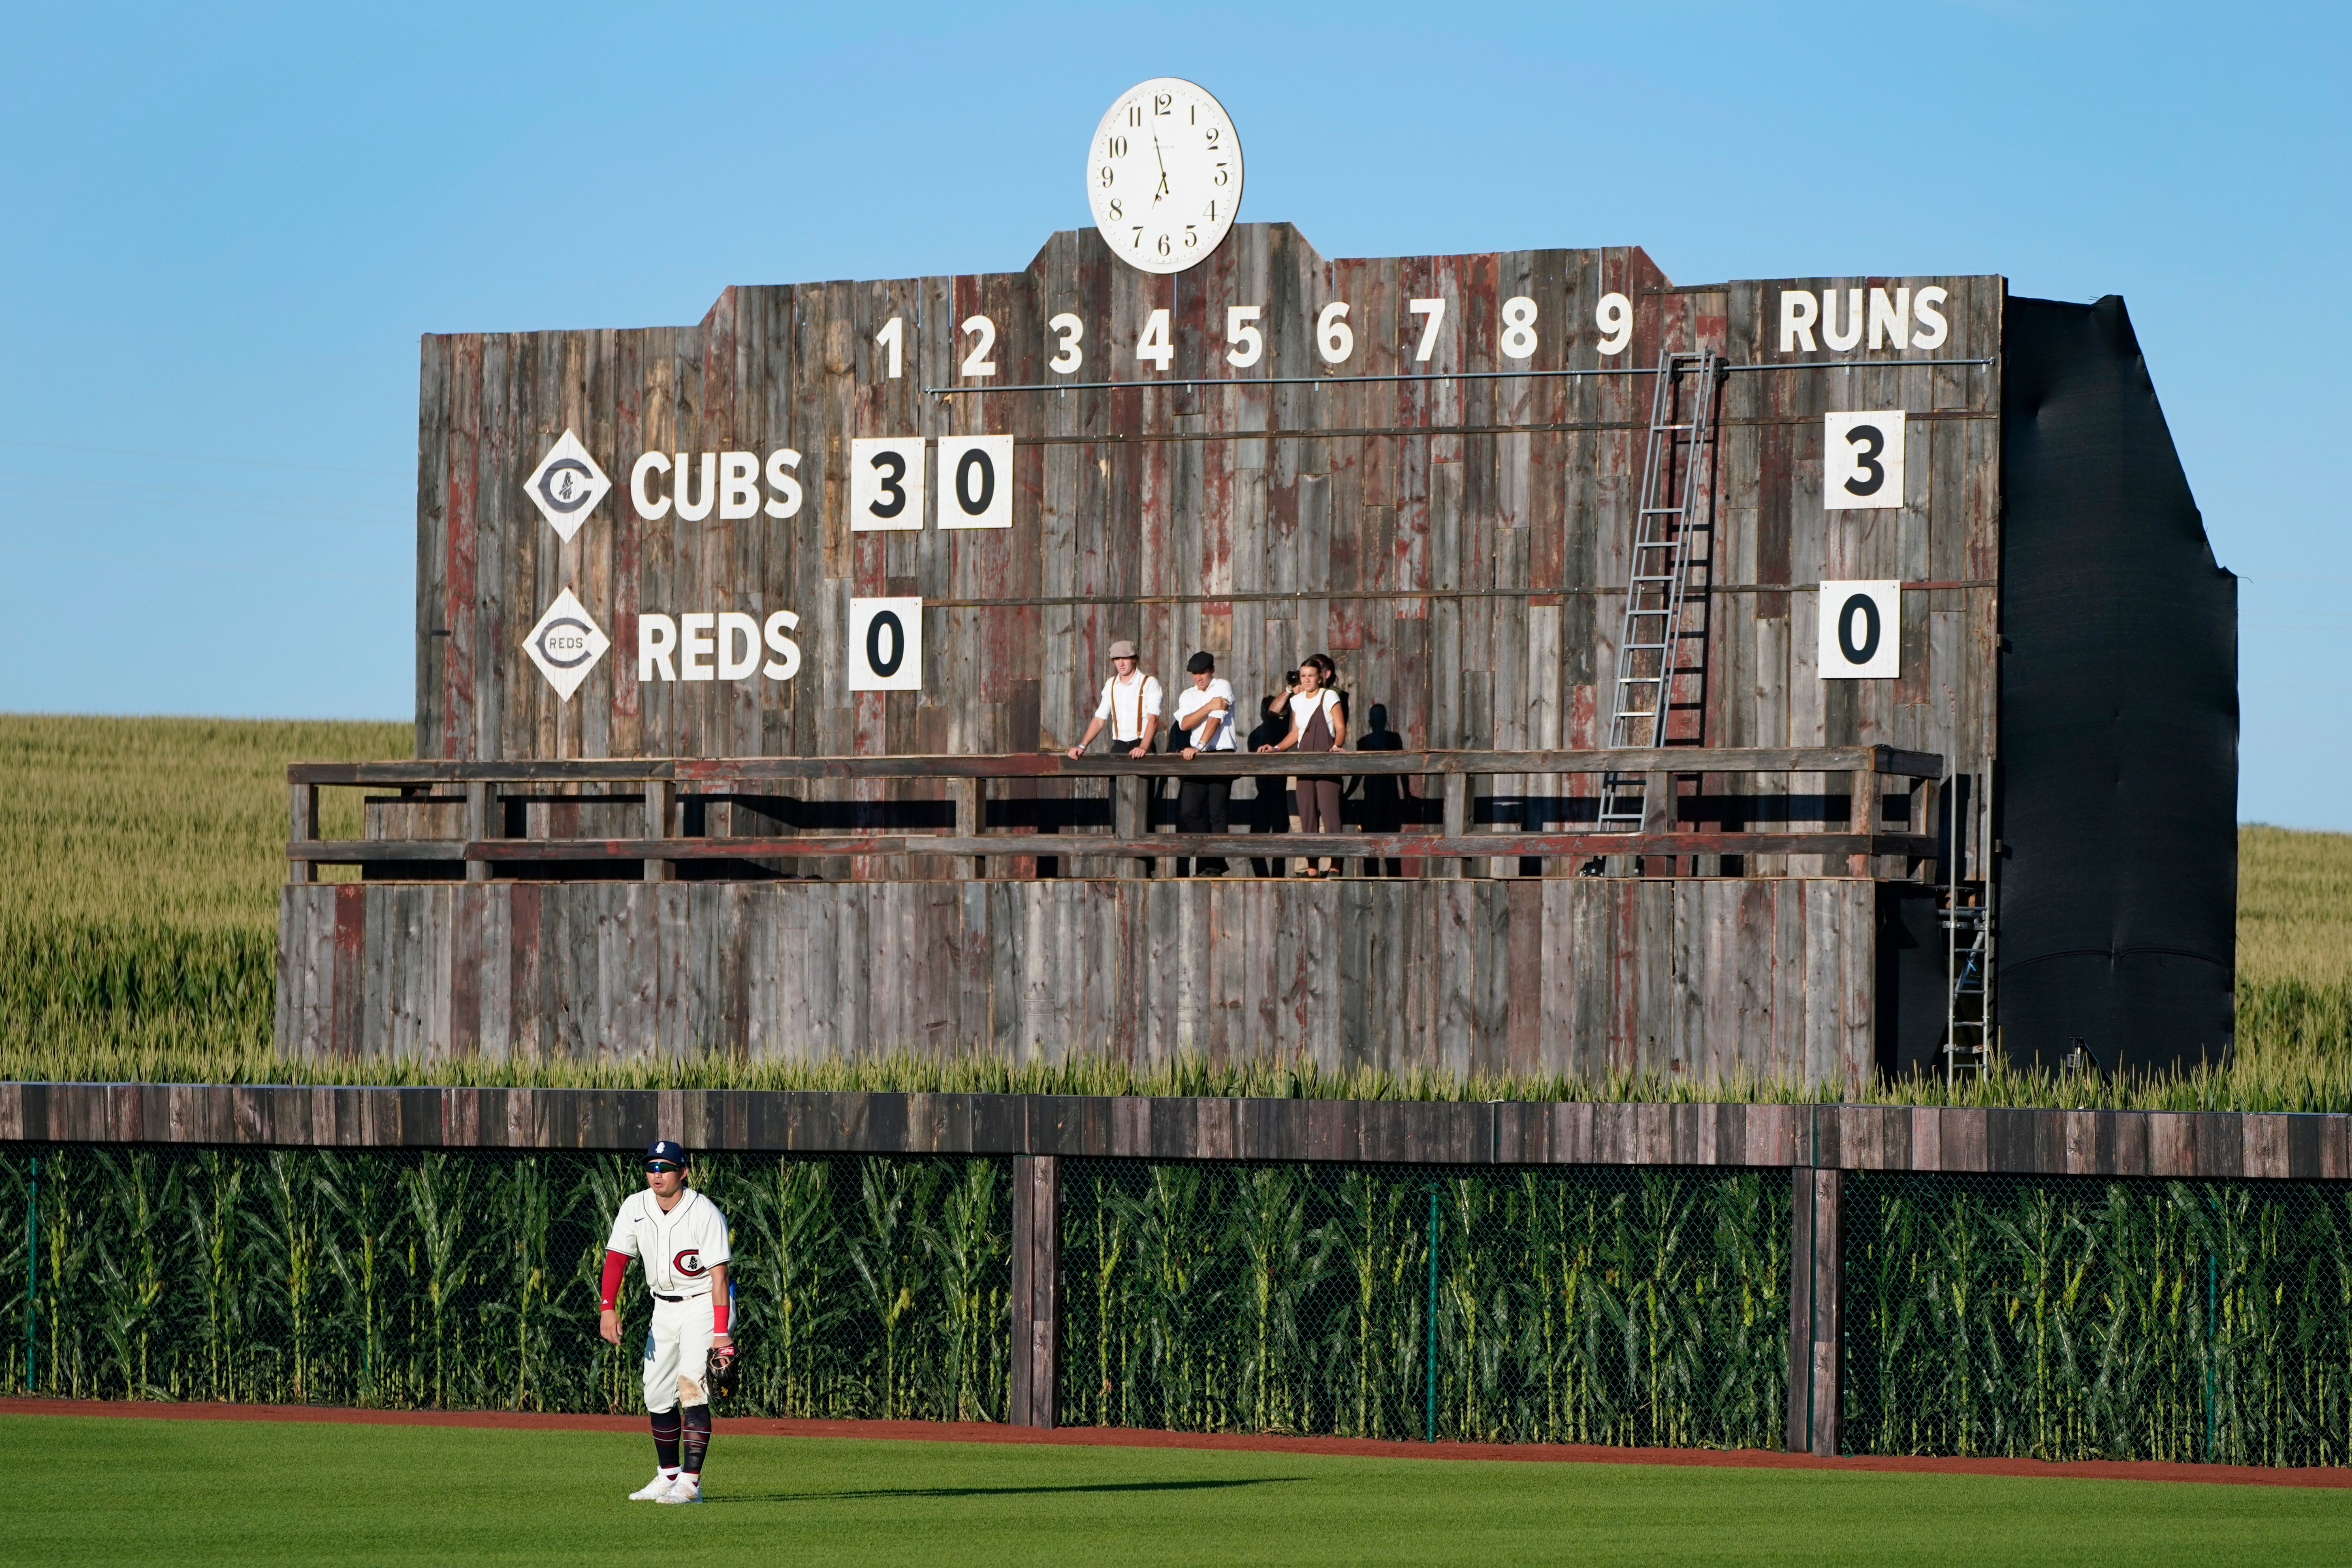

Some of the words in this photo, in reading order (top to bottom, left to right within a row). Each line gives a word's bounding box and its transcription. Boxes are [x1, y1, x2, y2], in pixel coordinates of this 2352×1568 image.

[1155, 94, 1172, 115] 12
[1191, 105, 1194, 125] 1
[1130, 106, 1140, 127] 11
[1109, 136, 1127, 158] 10
[1206, 128, 1219, 150] 2
[1101, 166, 1113, 188] 9
[1214, 163, 1227, 186] 3
[1110, 198, 1122, 221] 8
[1203, 199, 1219, 221] 4
[1132, 226, 1144, 248] 7
[1158, 234, 1170, 256] 6
[1185, 225, 1197, 247] 5
[1780, 286, 1948, 352] RUNS
[876, 318, 901, 378] 1
[961, 316, 995, 376] 2
[1049, 314, 1082, 373] 3
[1137, 309, 1173, 370] 4
[1227, 306, 1262, 367] 5
[1317, 302, 1353, 363] 6
[1410, 299, 1445, 361] 7
[1501, 297, 1537, 358] 8
[1596, 293, 1633, 354] 9
[1844, 425, 1884, 496] 3
[630, 448, 802, 521] CUBS
[869, 451, 906, 518] 3
[956, 448, 995, 515] 0
[1838, 593, 1880, 665] 0
[549, 637, 583, 649] REDS
[638, 610, 800, 681] REDS
[867, 610, 904, 677] 0
